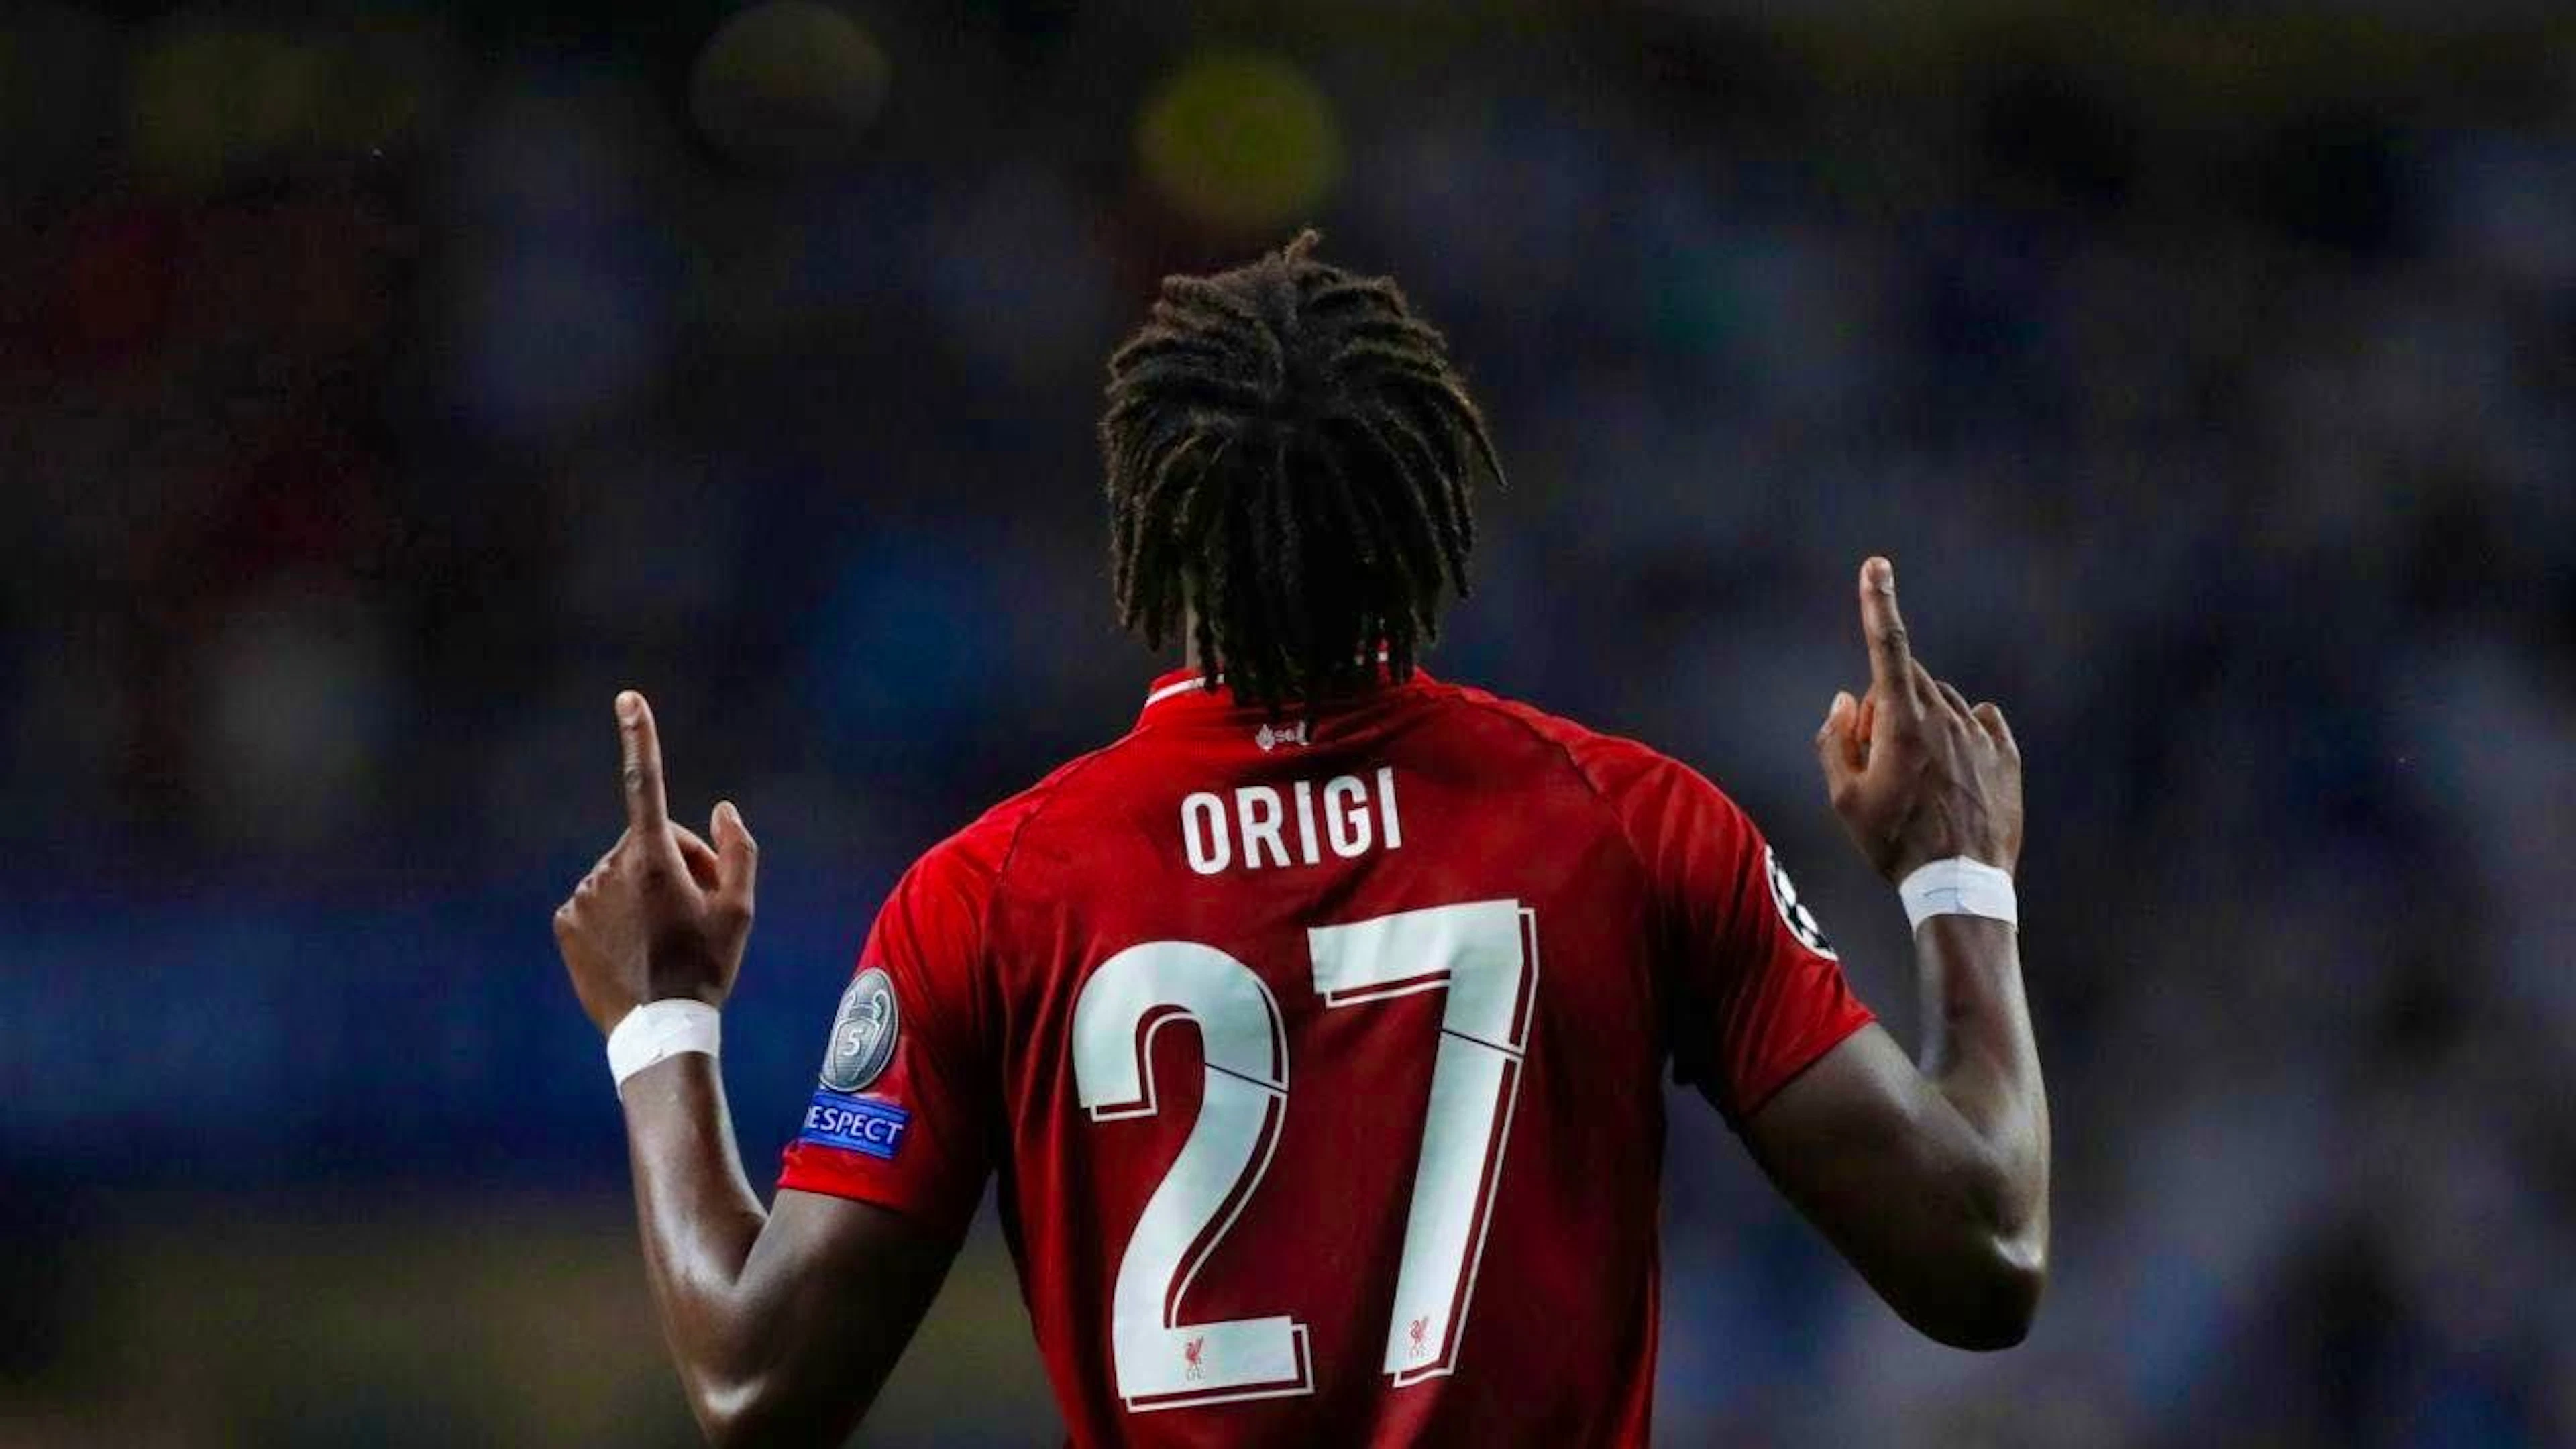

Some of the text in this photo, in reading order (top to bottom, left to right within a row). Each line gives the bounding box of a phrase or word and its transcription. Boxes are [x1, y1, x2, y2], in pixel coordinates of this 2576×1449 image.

[1181, 766, 1401, 874] ORIGI
[843, 1028, 864, 1055] 5
[1073, 899, 1538, 1413] 27
